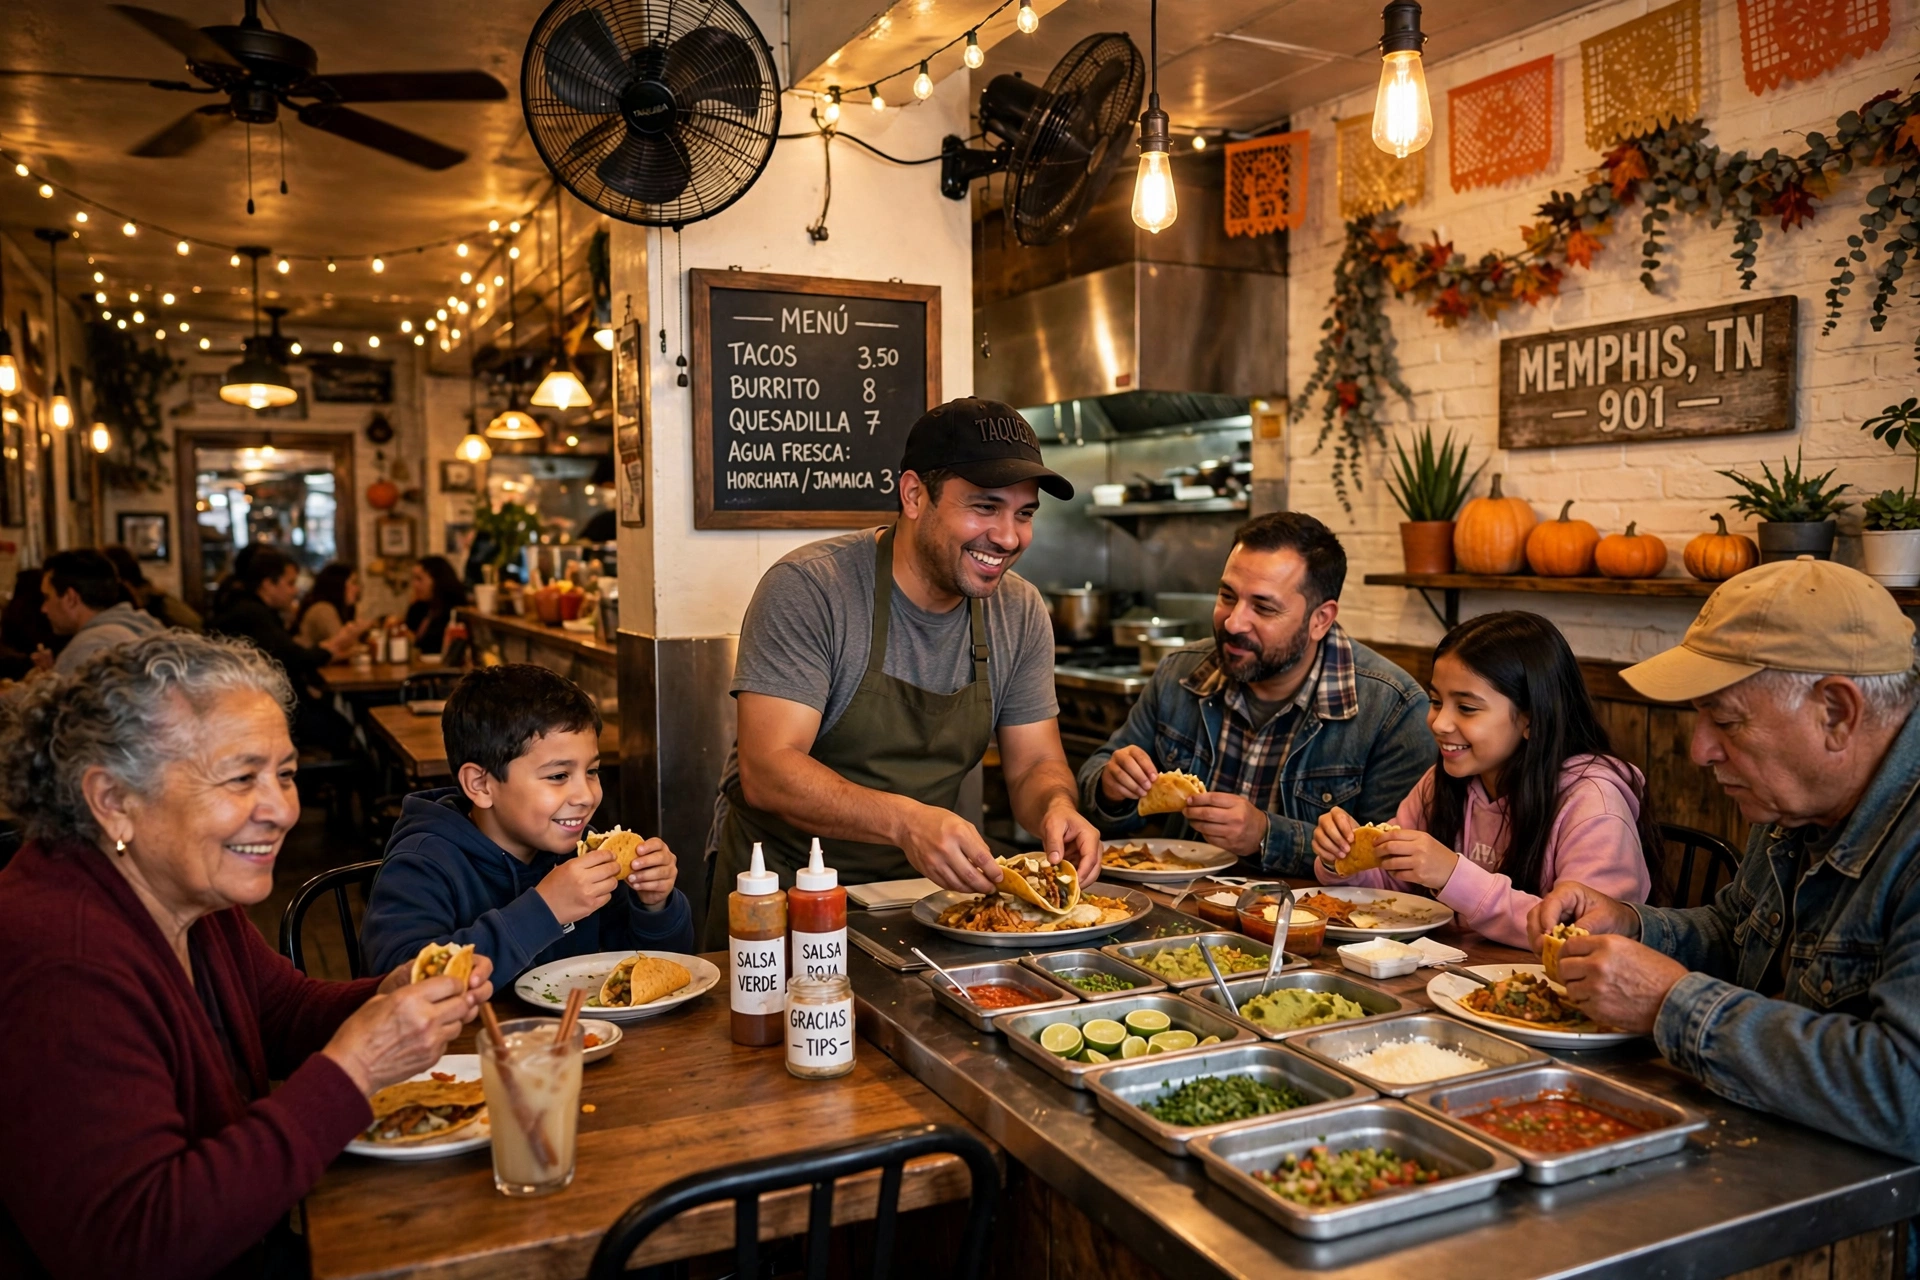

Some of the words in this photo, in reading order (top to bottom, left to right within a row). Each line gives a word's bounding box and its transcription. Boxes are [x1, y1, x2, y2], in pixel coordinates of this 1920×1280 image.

[780, 304, 849, 336] MENÚ
[727, 341, 798, 368] TACOS
[857, 346, 899, 370] 3.50
[1517, 324, 1698, 395] MEMPHIS,
[1706, 313, 1764, 373] TN
[729, 375, 821, 400] BURRITO
[862, 377, 877, 403] 8
[728, 407, 851, 434] QUESADILLA
[864, 409, 881, 435] 7
[1598, 385, 1664, 433] 901
[728, 440, 775, 463] AGUA
[782, 442, 851, 463] FRESCA:
[879, 468, 895, 494] 3
[737, 951, 777, 969] SALSA
[802, 941, 842, 960] SALSA
[737, 973, 778, 993] VERDE
[790, 1009, 847, 1030] GRACIAS
[805, 1037, 838, 1057] TIPS
